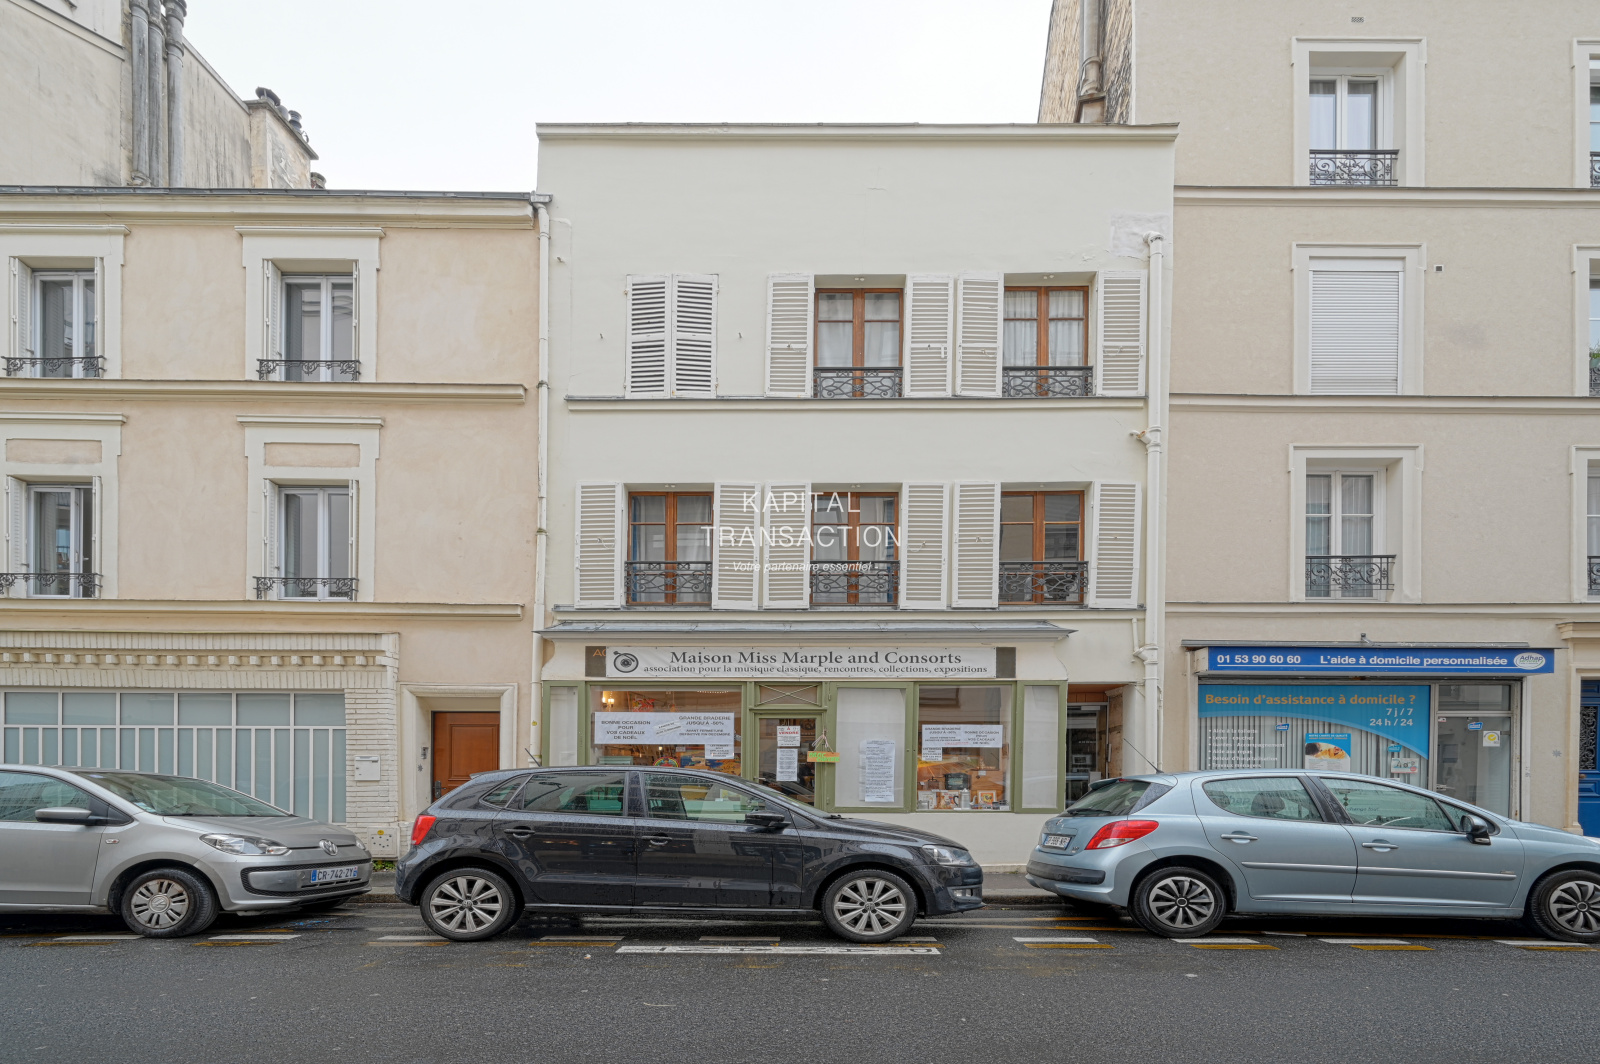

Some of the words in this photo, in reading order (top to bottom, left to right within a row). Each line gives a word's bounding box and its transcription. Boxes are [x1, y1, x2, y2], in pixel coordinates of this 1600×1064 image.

[670, 651, 732, 664] Maison
[737, 651, 777, 664] Miss
[782, 651, 843, 667] Marple
[847, 651, 879, 664] and
[884, 651, 962, 664] Consorts
[1217, 655, 1230, 664] 01
[1234, 655, 1249, 664] 53
[1252, 655, 1266, 664] 90
[1269, 655, 1284, 664] 60
[1286, 655, 1301, 664] 60
[1320, 655, 1356, 664] L'aide
[1358, 656, 1366, 664] à
[1369, 656, 1421, 665] domicile
[1423, 656, 1508, 666] personnalisée
[1519, 654, 1543, 662] Adhap
[643, 665, 695, 673] association
[698, 666, 721, 675] pour
[723, 665, 732, 673] la
[734, 665, 774, 675] musique
[776, 665, 822, 675] classique,
[824, 665, 877, 674] rencontres,
[878, 665, 932, 674] collections,
[934, 665, 988, 675] expositions
[1205, 694, 1250, 704] Besoin
[1253, 694, 1335, 704] d'assistance
[1338, 694, 1346, 704] à
[1350, 694, 1406, 704] domicile
[1409, 694, 1416, 704] ?
[1394, 708, 1398, 717] j
[1400, 708, 1404, 716] /
[1369, 718, 1382, 726] 24
[1384, 718, 1391, 726] h
[1393, 718, 1399, 726] /
[1400, 718, 1413, 726] 24
[317, 867, 354, 881] CR-742-ZY
